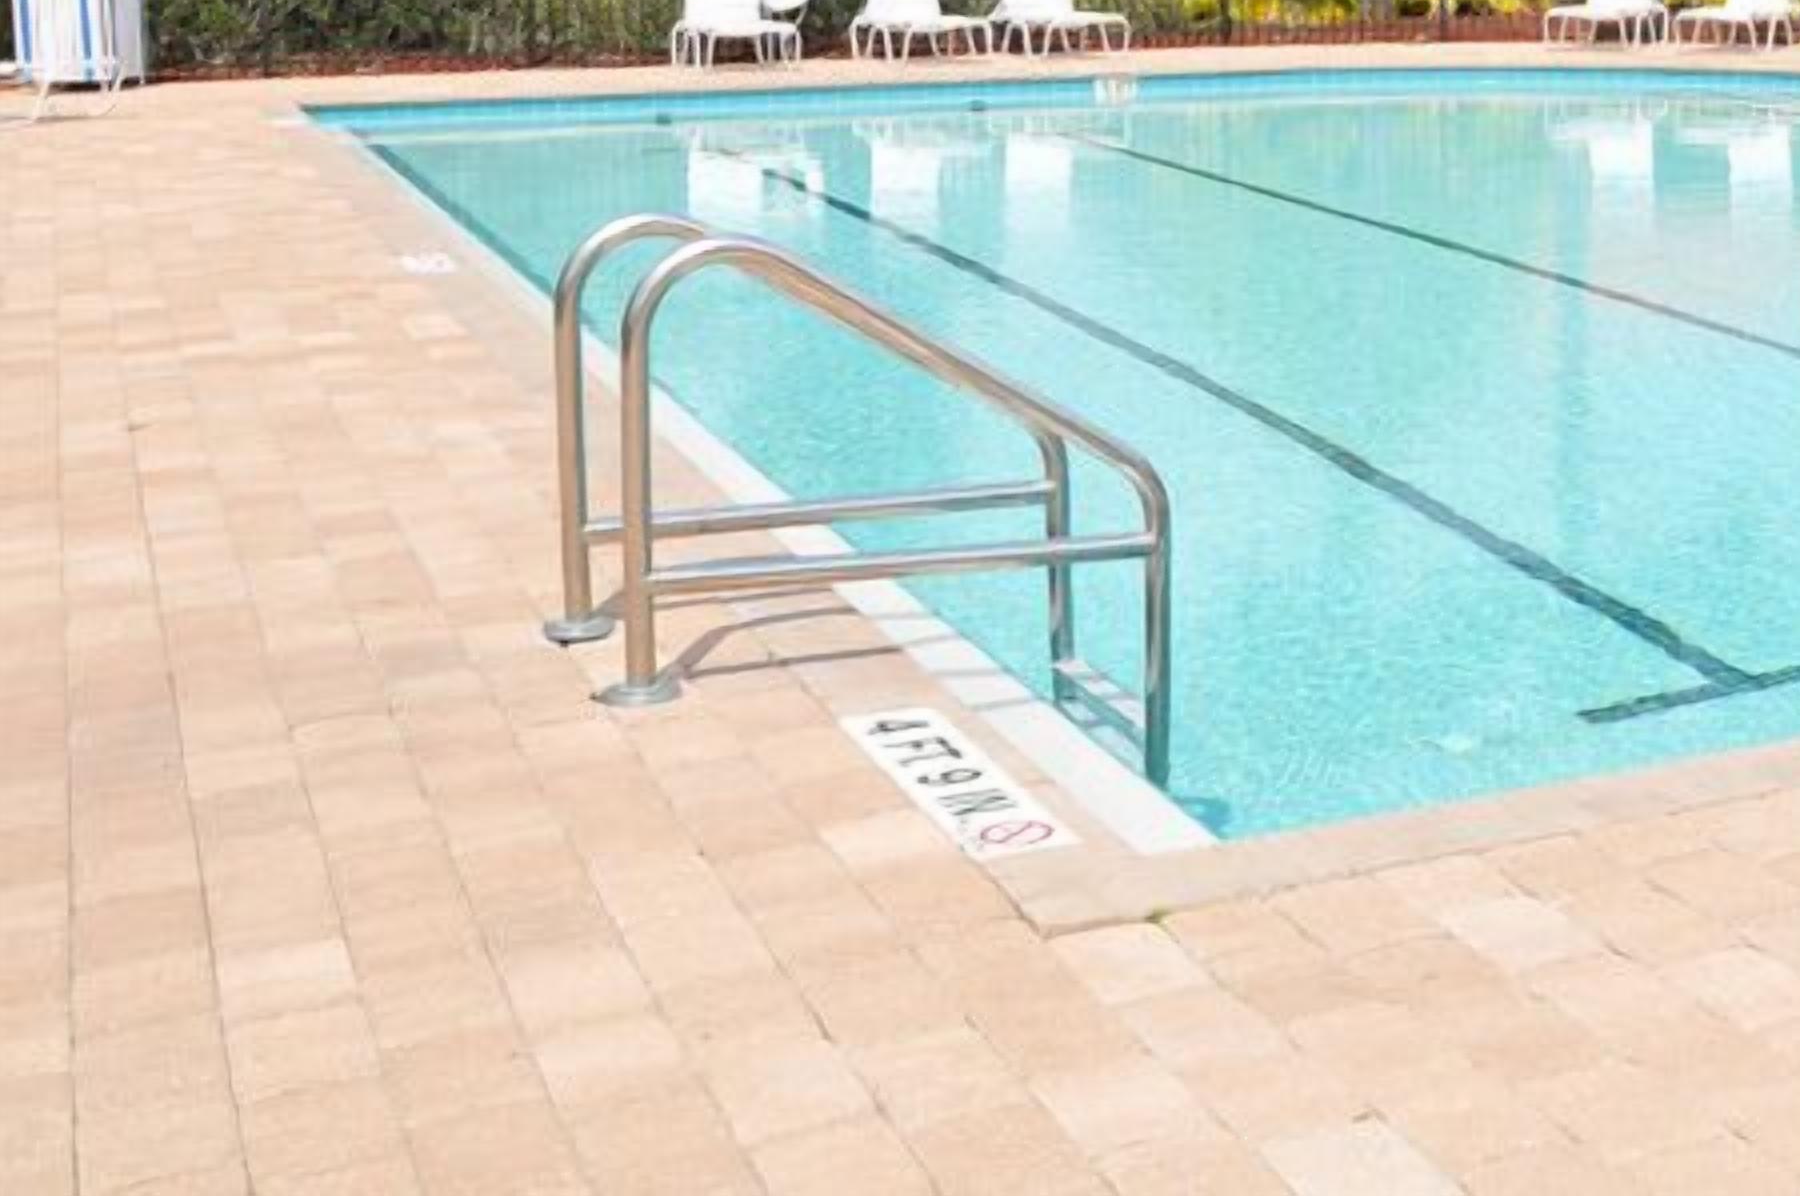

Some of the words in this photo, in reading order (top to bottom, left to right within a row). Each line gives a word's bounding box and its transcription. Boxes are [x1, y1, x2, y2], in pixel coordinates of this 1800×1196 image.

[868, 720, 930, 735] 4
[883, 736, 962, 766] FT
[916, 768, 982, 786] 9
